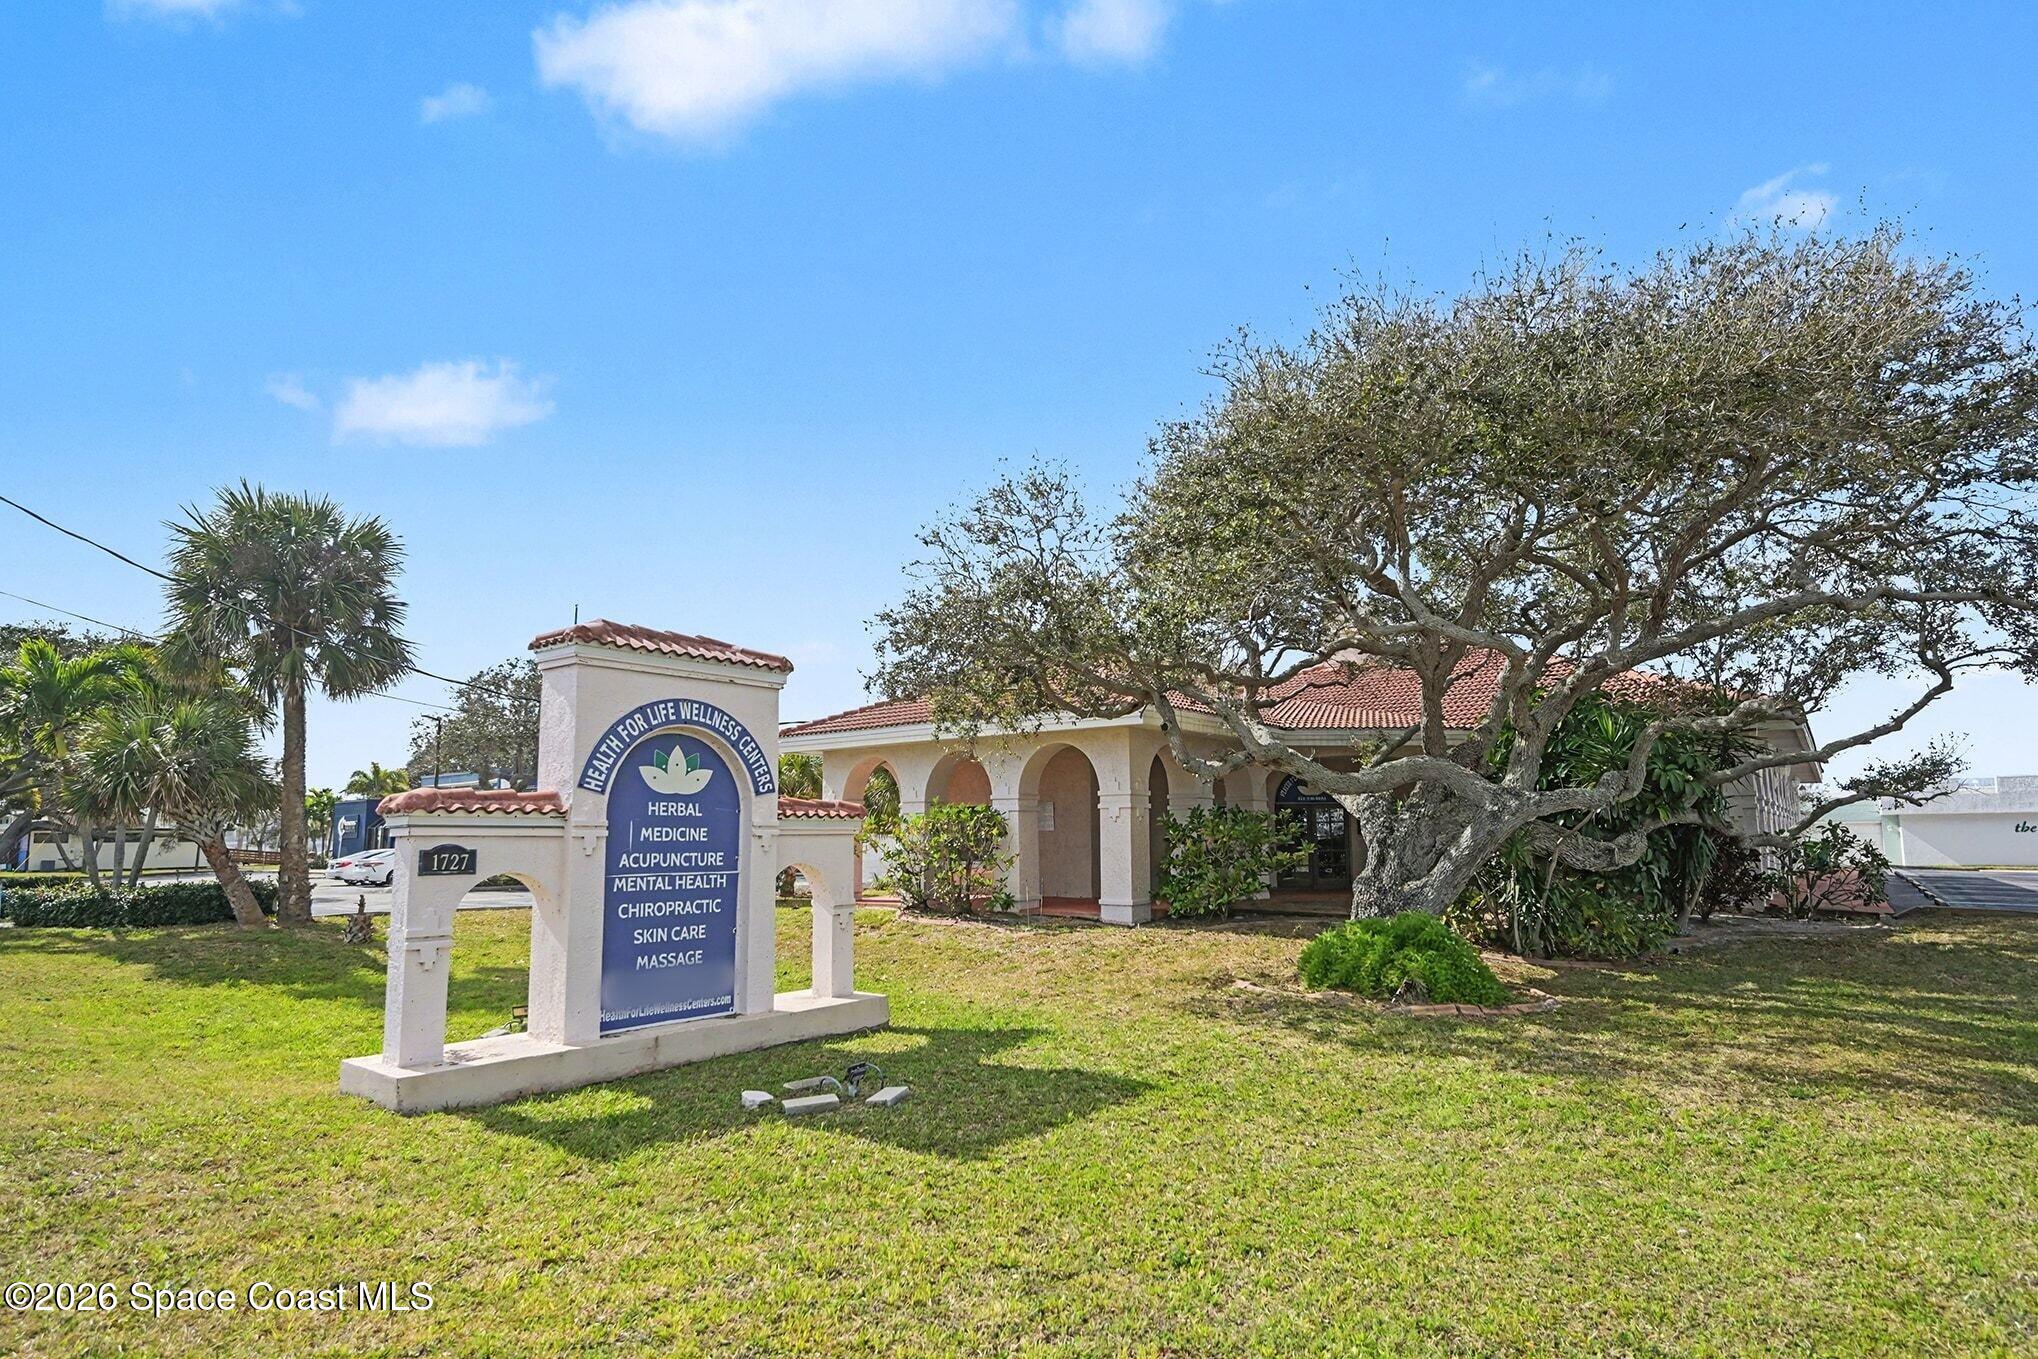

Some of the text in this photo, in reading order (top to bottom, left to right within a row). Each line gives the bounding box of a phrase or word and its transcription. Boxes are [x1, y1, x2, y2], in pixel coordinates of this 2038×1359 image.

[583, 701, 774, 793] HEALTH FOR LIFE WELLNESS CENTERS
[648, 802, 703, 817] HERBAL
[640, 827, 708, 842] MEDICINE
[432, 853, 469, 871] 1727
[618, 852, 725, 868] ACUPUNCTURE
[613, 874, 727, 892] MENTAL HEALTH
[618, 899, 722, 919] CHIROPRACTIC
[633, 925, 707, 944] SKIN CARE
[636, 950, 704, 970] MASSAGE
